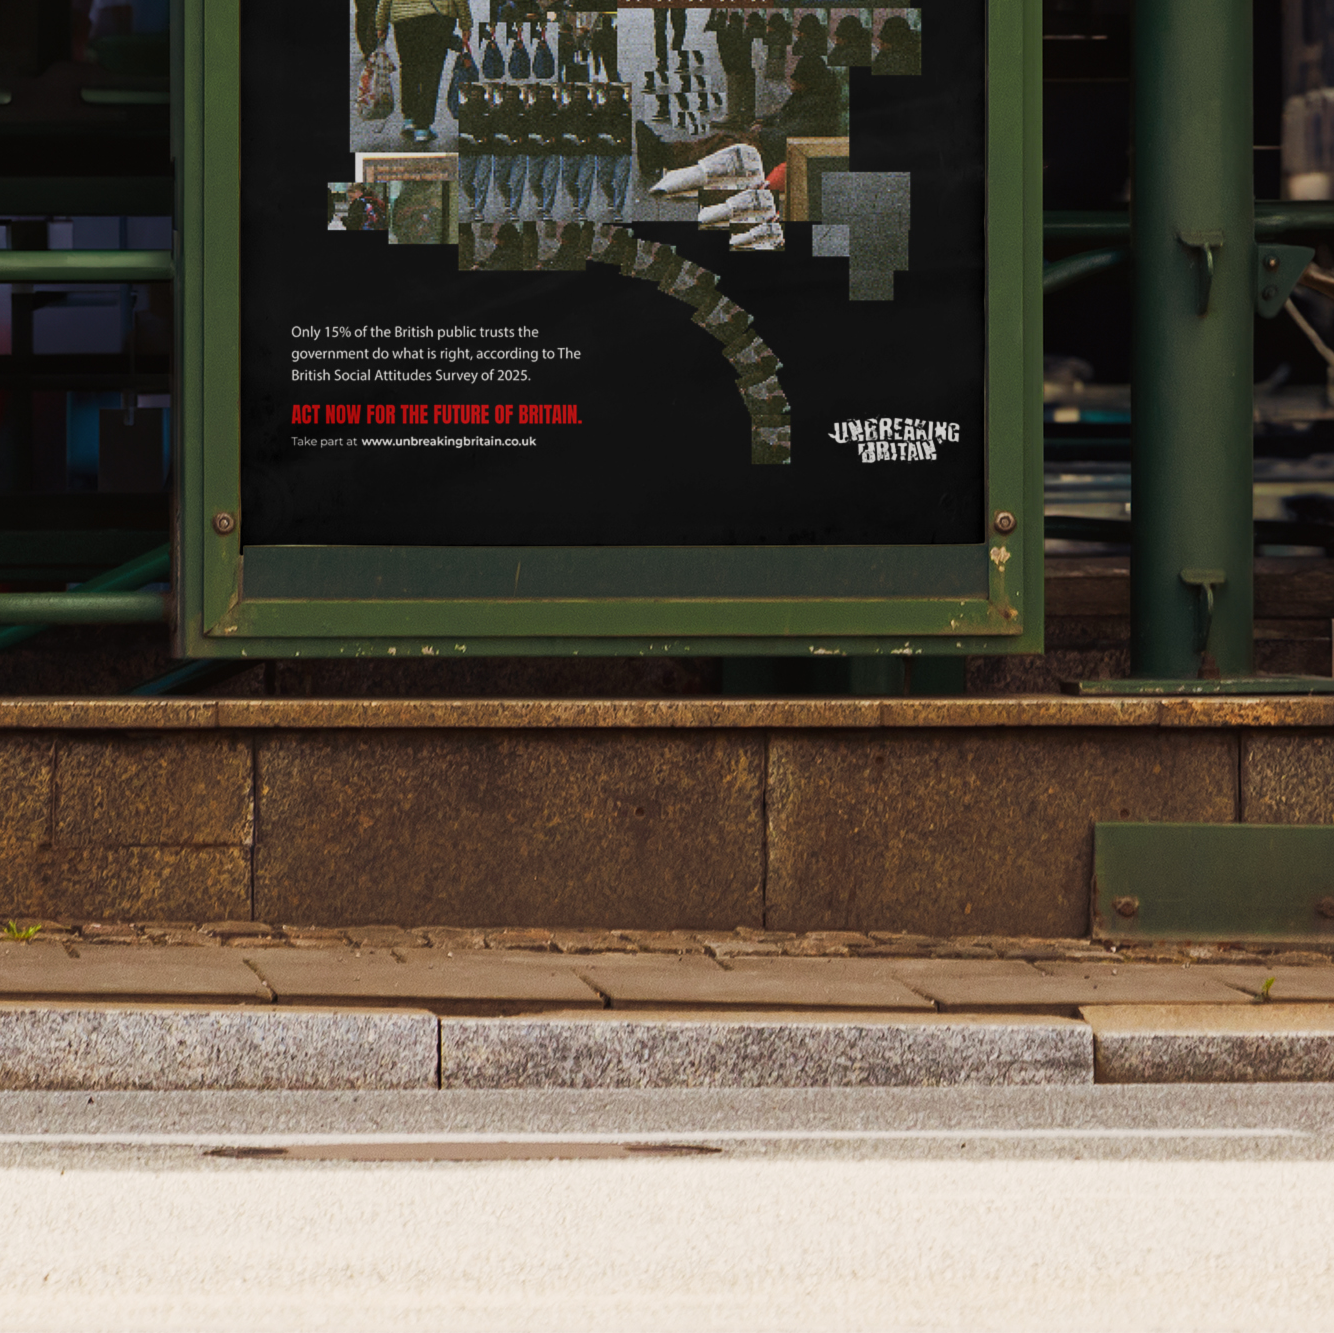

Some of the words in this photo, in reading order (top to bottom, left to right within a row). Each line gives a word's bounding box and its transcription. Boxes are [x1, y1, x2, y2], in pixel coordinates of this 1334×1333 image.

[291, 325, 321, 341] Only
[324, 326, 352, 338] 15%
[354, 325, 369, 338] of
[370, 325, 392, 338] the
[394, 325, 434, 338] British
[437, 325, 477, 341] public
[479, 326, 515, 338] trusts
[517, 325, 539, 338] the
[291, 348, 370, 363] government
[372, 346, 390, 360] do
[391, 346, 424, 360] what
[427, 347, 437, 360] is
[440, 346, 474, 363] right,
[476, 346, 539, 363] according
[541, 348, 556, 360] to
[556, 346, 582, 360] The
[291, 368, 331, 382] British
[334, 368, 371, 382] Social
[374, 368, 432, 382] Attitudes
[435, 368, 479, 385] Survey
[480, 368, 495, 382] of
[497, 369, 531, 382] 2025.
[291, 404, 321, 425] ACT
[325, 404, 362, 425] NOW
[366, 404, 396, 425] FOR
[400, 404, 429, 425] THE
[433, 404, 490, 425] FUTURE
[494, 404, 514, 425] OF
[518, 404, 583, 425] BRITAIN.
[827, 417, 961, 445] UNBREAKING
[291, 436, 318, 447] Take
[320, 437, 344, 449] part
[346, 437, 358, 447] at
[361, 435, 537, 449] www.unbreakingbritain.co.uk
[857, 440, 938, 464] BRITAIN
